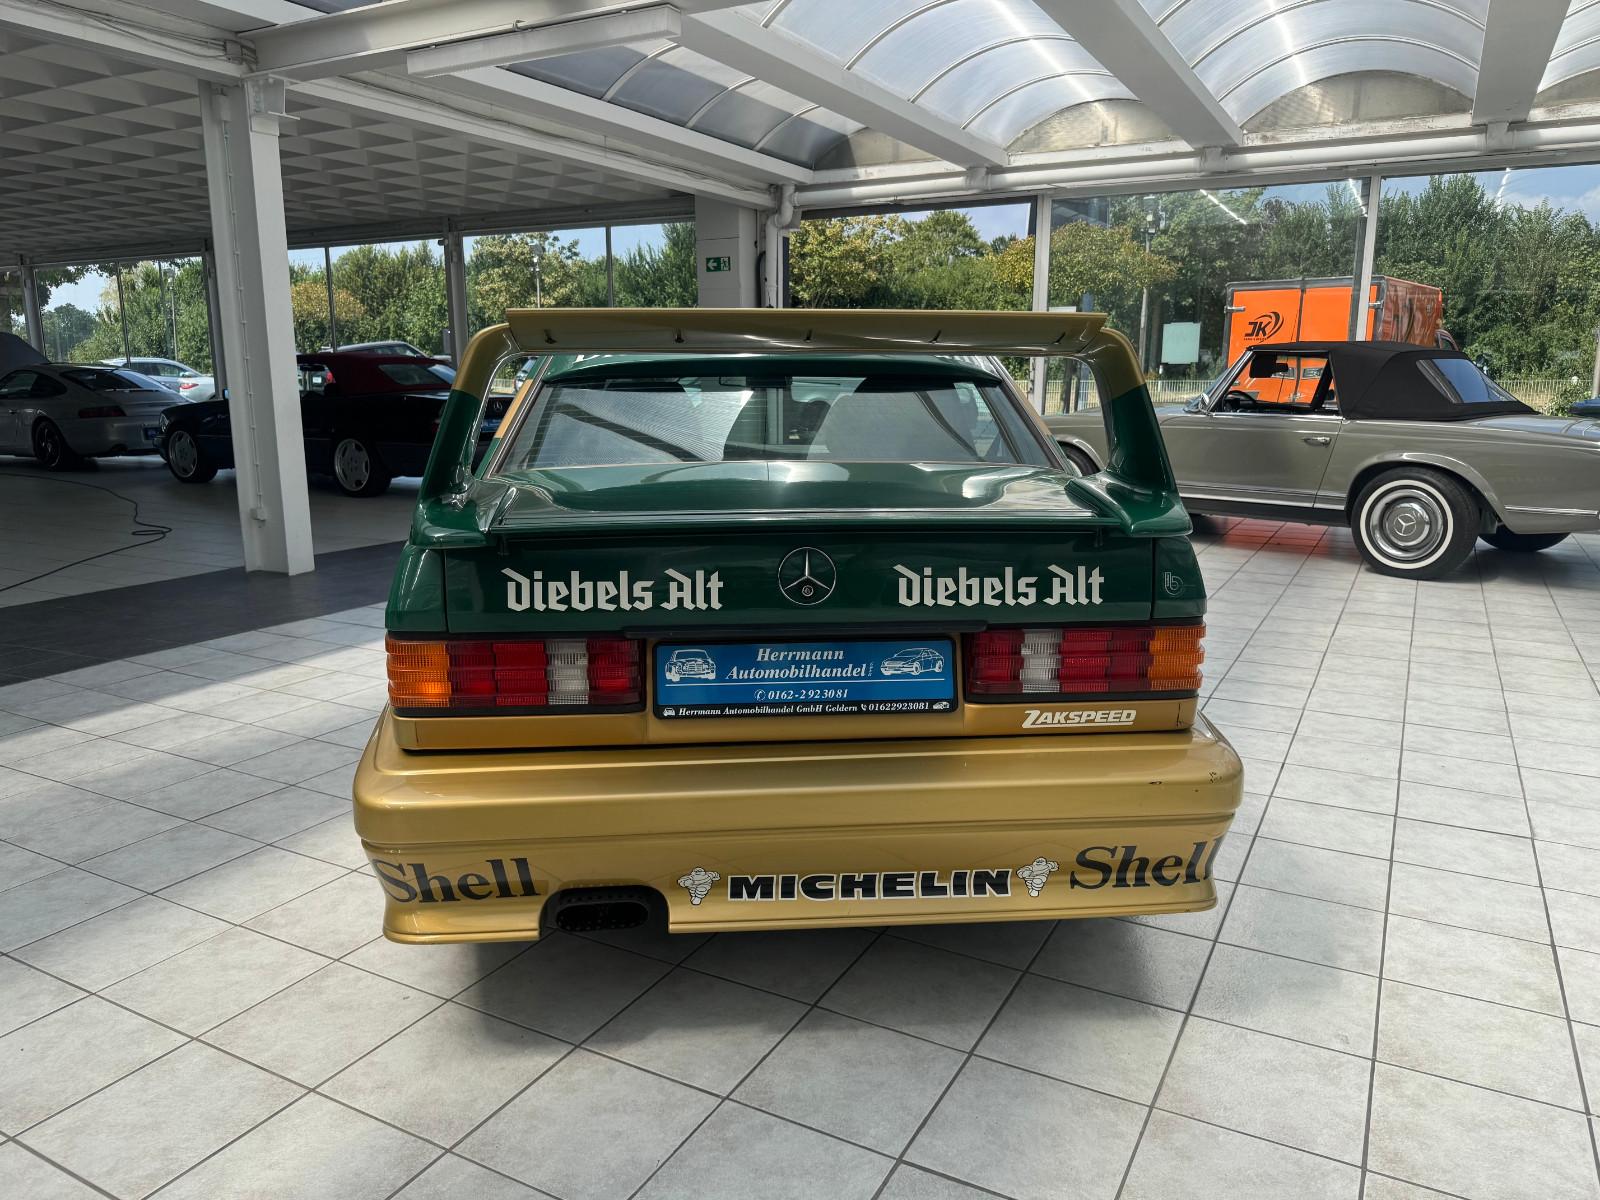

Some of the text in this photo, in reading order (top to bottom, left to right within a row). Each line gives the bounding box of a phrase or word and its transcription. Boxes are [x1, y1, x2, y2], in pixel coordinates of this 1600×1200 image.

[1245, 321, 1272, 337] JK
[501, 567, 724, 612] Diebels Alt
[893, 564, 1105, 607] Diebels Alt
[757, 647, 845, 662] Herrmann
[725, 663, 867, 680] Automobilhandel
[678, 701, 930, 717] Herrmann Automobilhandel GmbH Geldern 01622923081
[1022, 709, 1137, 729] ZAKSPEED
[1069, 839, 1219, 890] Shell
[372, 857, 541, 904] Shell
[727, 869, 1012, 902] MICHELIN
